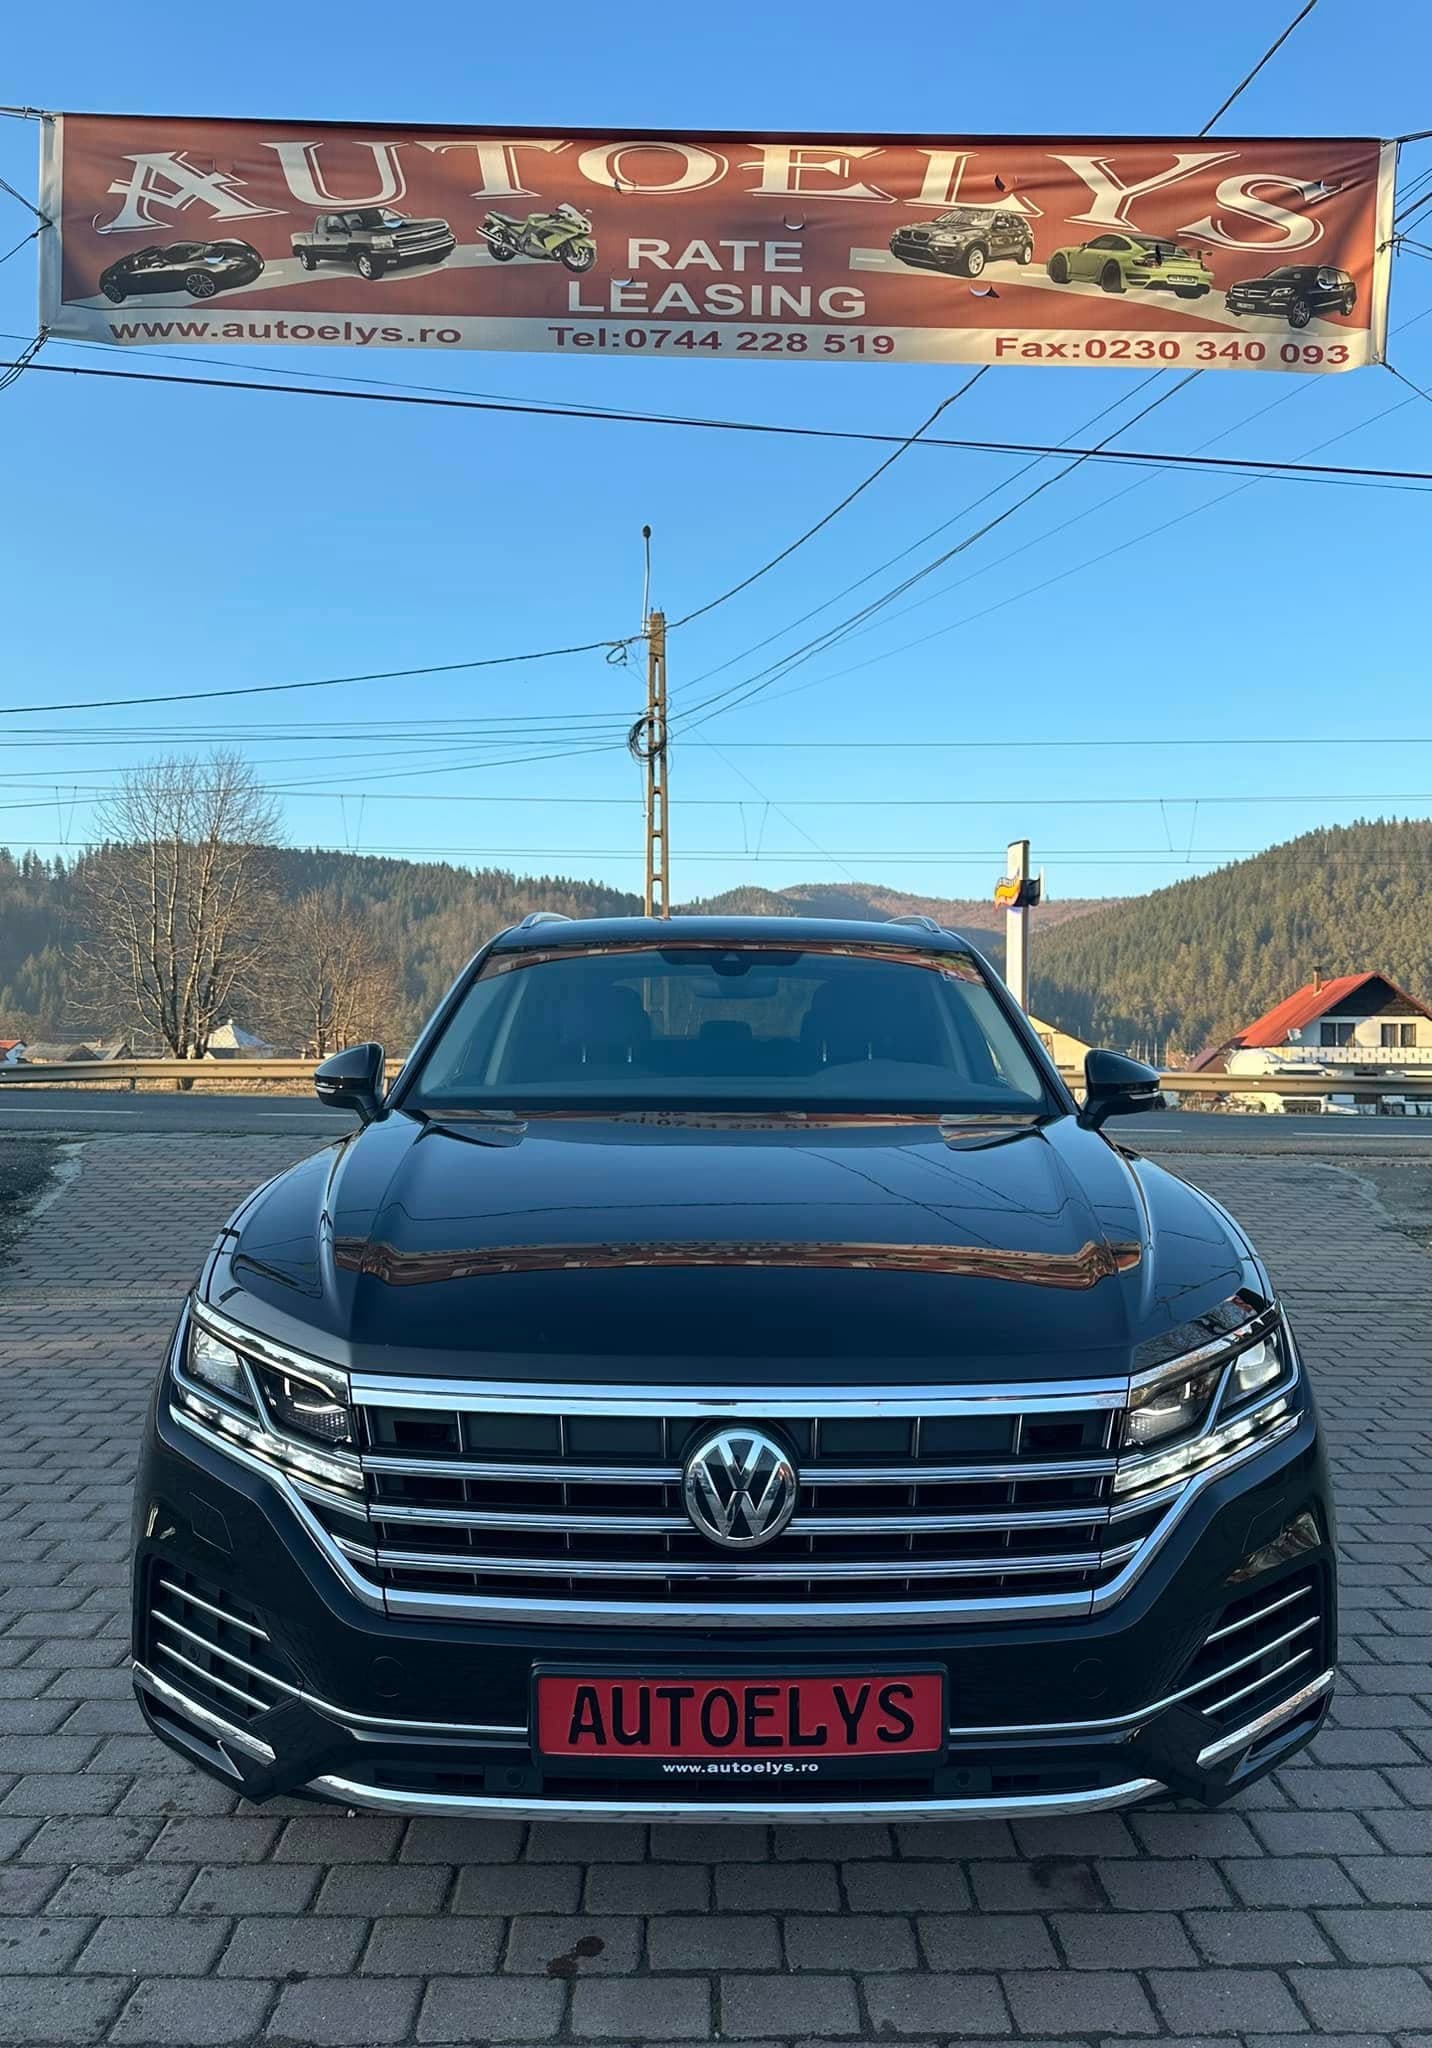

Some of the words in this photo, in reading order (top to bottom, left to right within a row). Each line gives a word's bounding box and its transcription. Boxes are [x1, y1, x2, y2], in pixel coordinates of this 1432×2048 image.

[92, 141, 1324, 254] AUTOELYS
[628, 238, 803, 272] RATE
[568, 281, 866, 318] LEASING
[109, 320, 462, 345] www.autoelys.ro
[548, 326, 722, 350] Tel:0744
[736, 332, 808, 352] 228
[823, 334, 895, 355] 519
[995, 337, 1181, 360] Fax:0230
[1195, 341, 1266, 361] 340
[1280, 343, 1350, 364] 093
[568, 1684, 915, 1748] AUTOELYS
[662, 1762, 819, 1775] www.autoelys.ro
